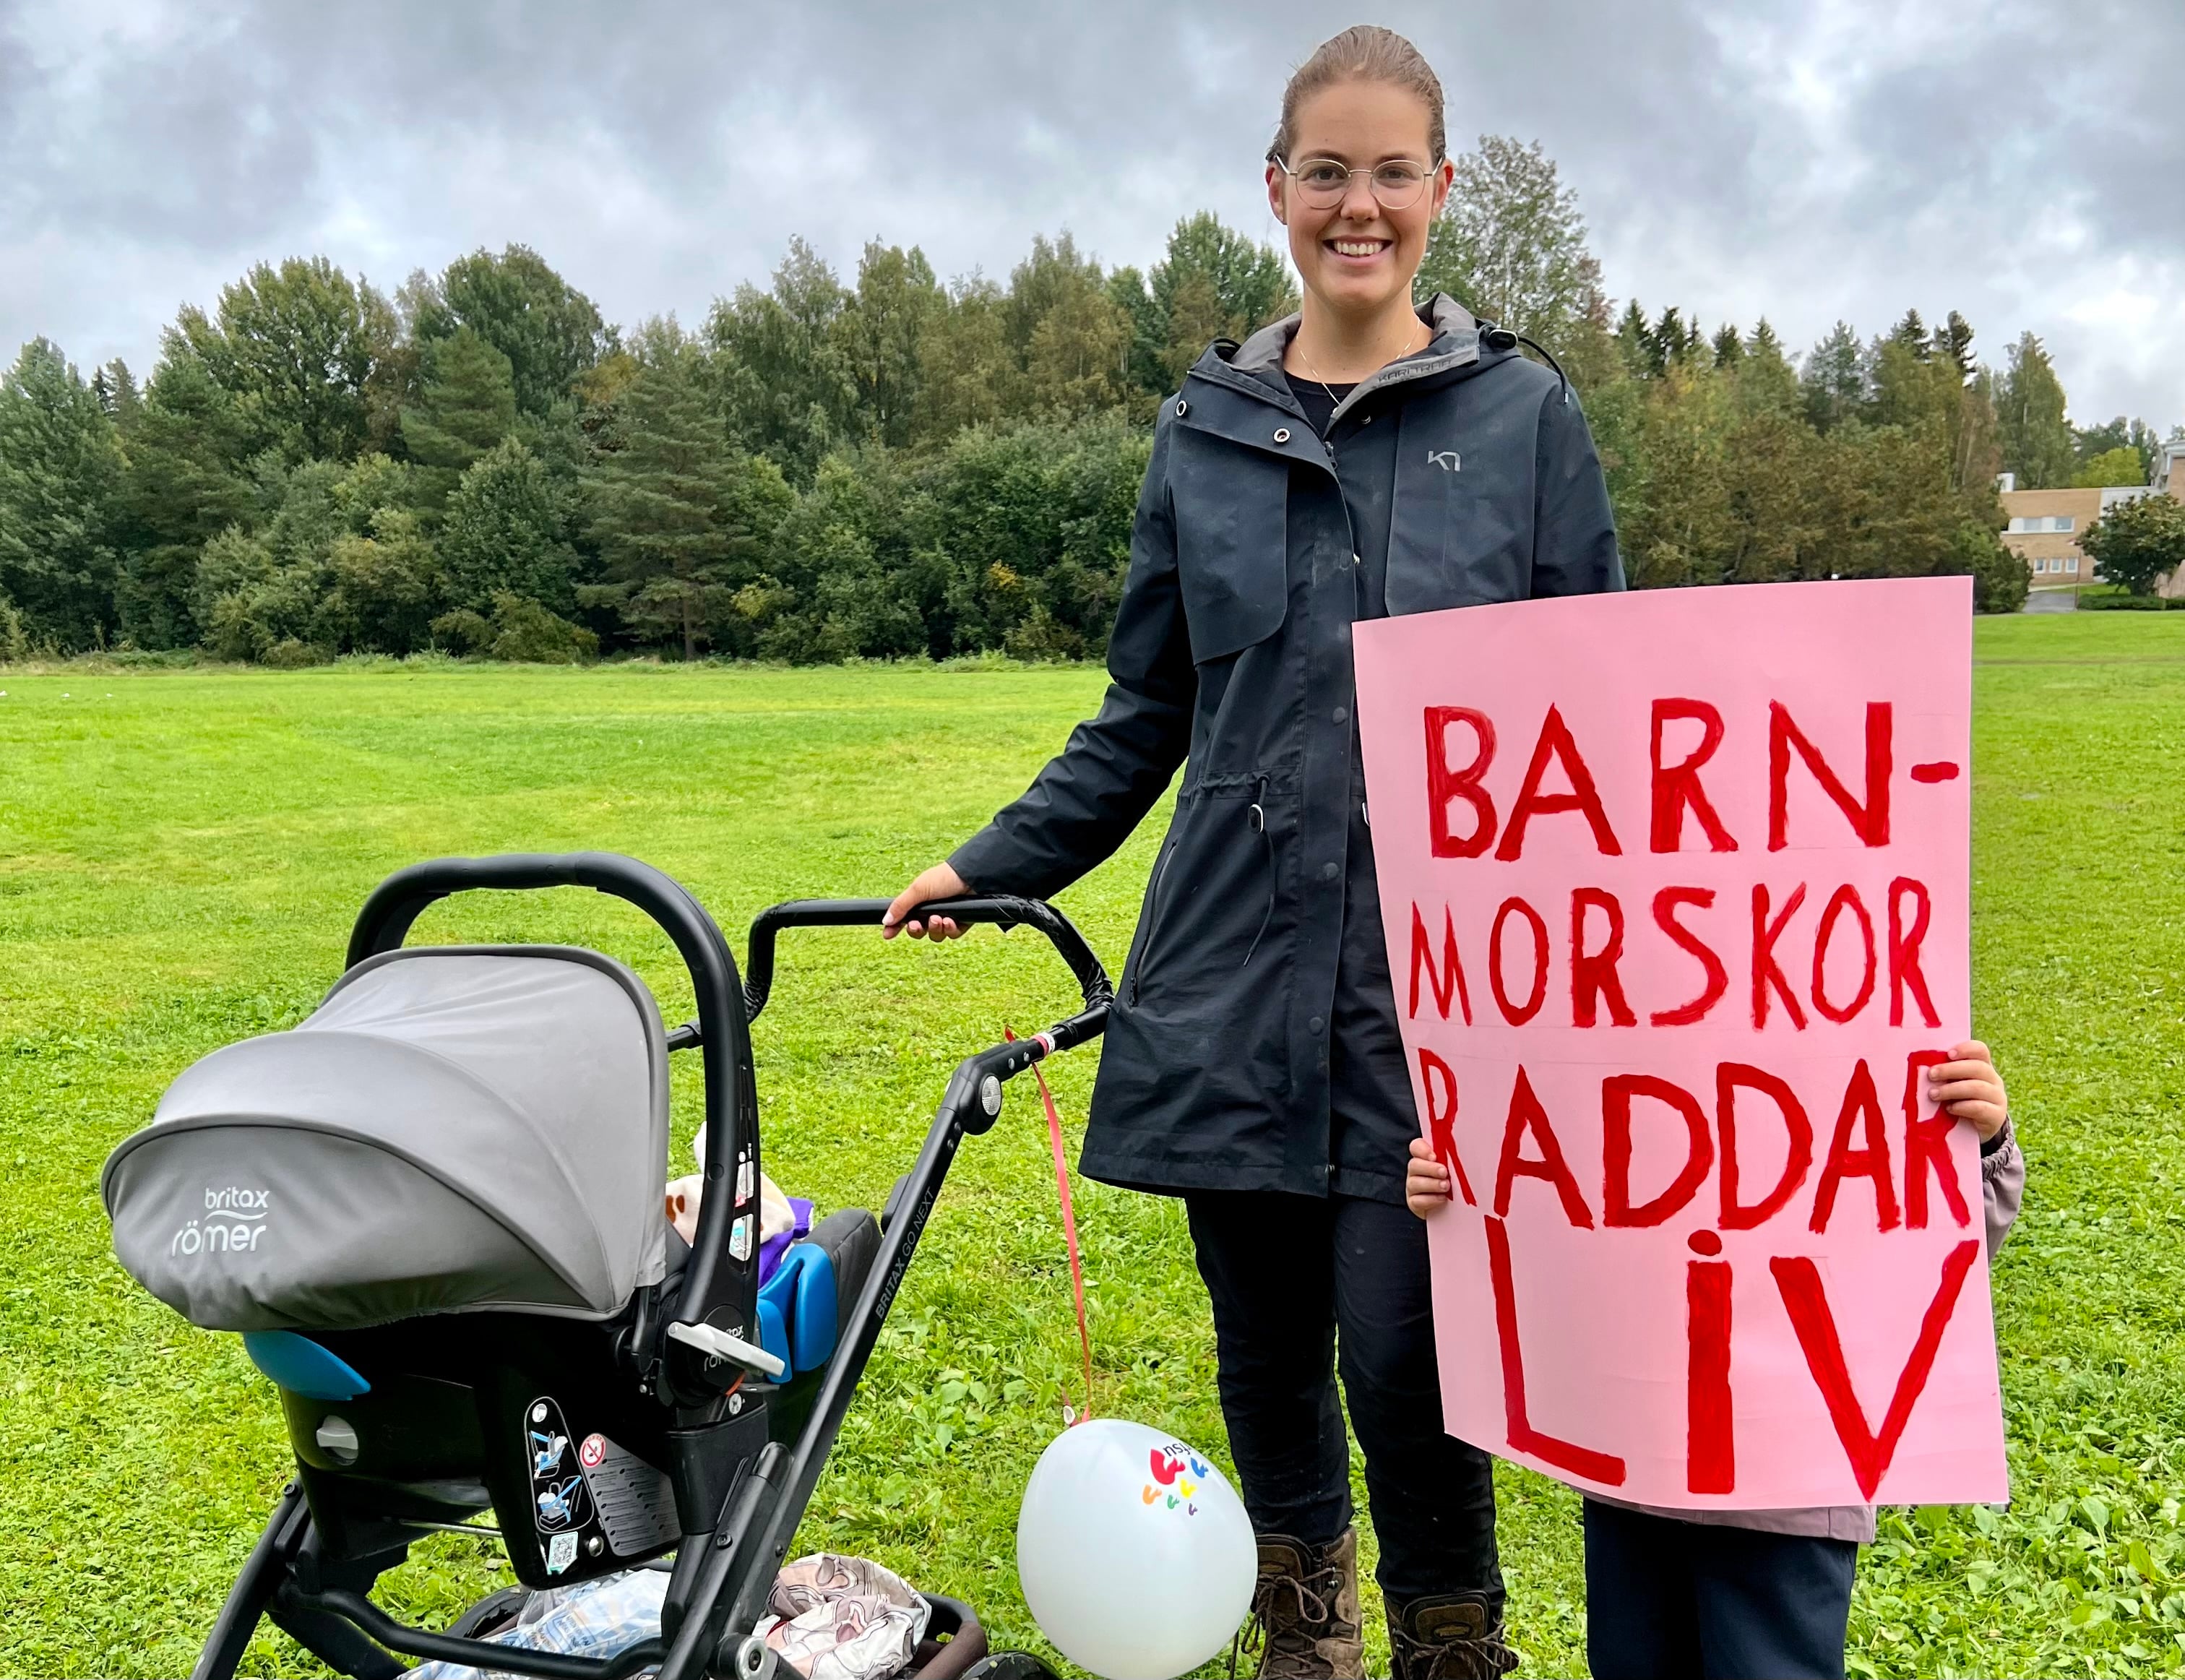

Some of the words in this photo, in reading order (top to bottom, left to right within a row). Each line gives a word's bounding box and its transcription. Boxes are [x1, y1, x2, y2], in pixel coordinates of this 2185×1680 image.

[1423, 698, 1960, 862] BARN-
[1409, 876, 1942, 1030] MORSKOR
[172, 1220, 267, 1257] römer
[204, 1186, 270, 1210] britax
[876, 1257, 905, 1319] BRITAX
[902, 1233, 916, 1257] GO
[913, 1186, 934, 1231] NEXT
